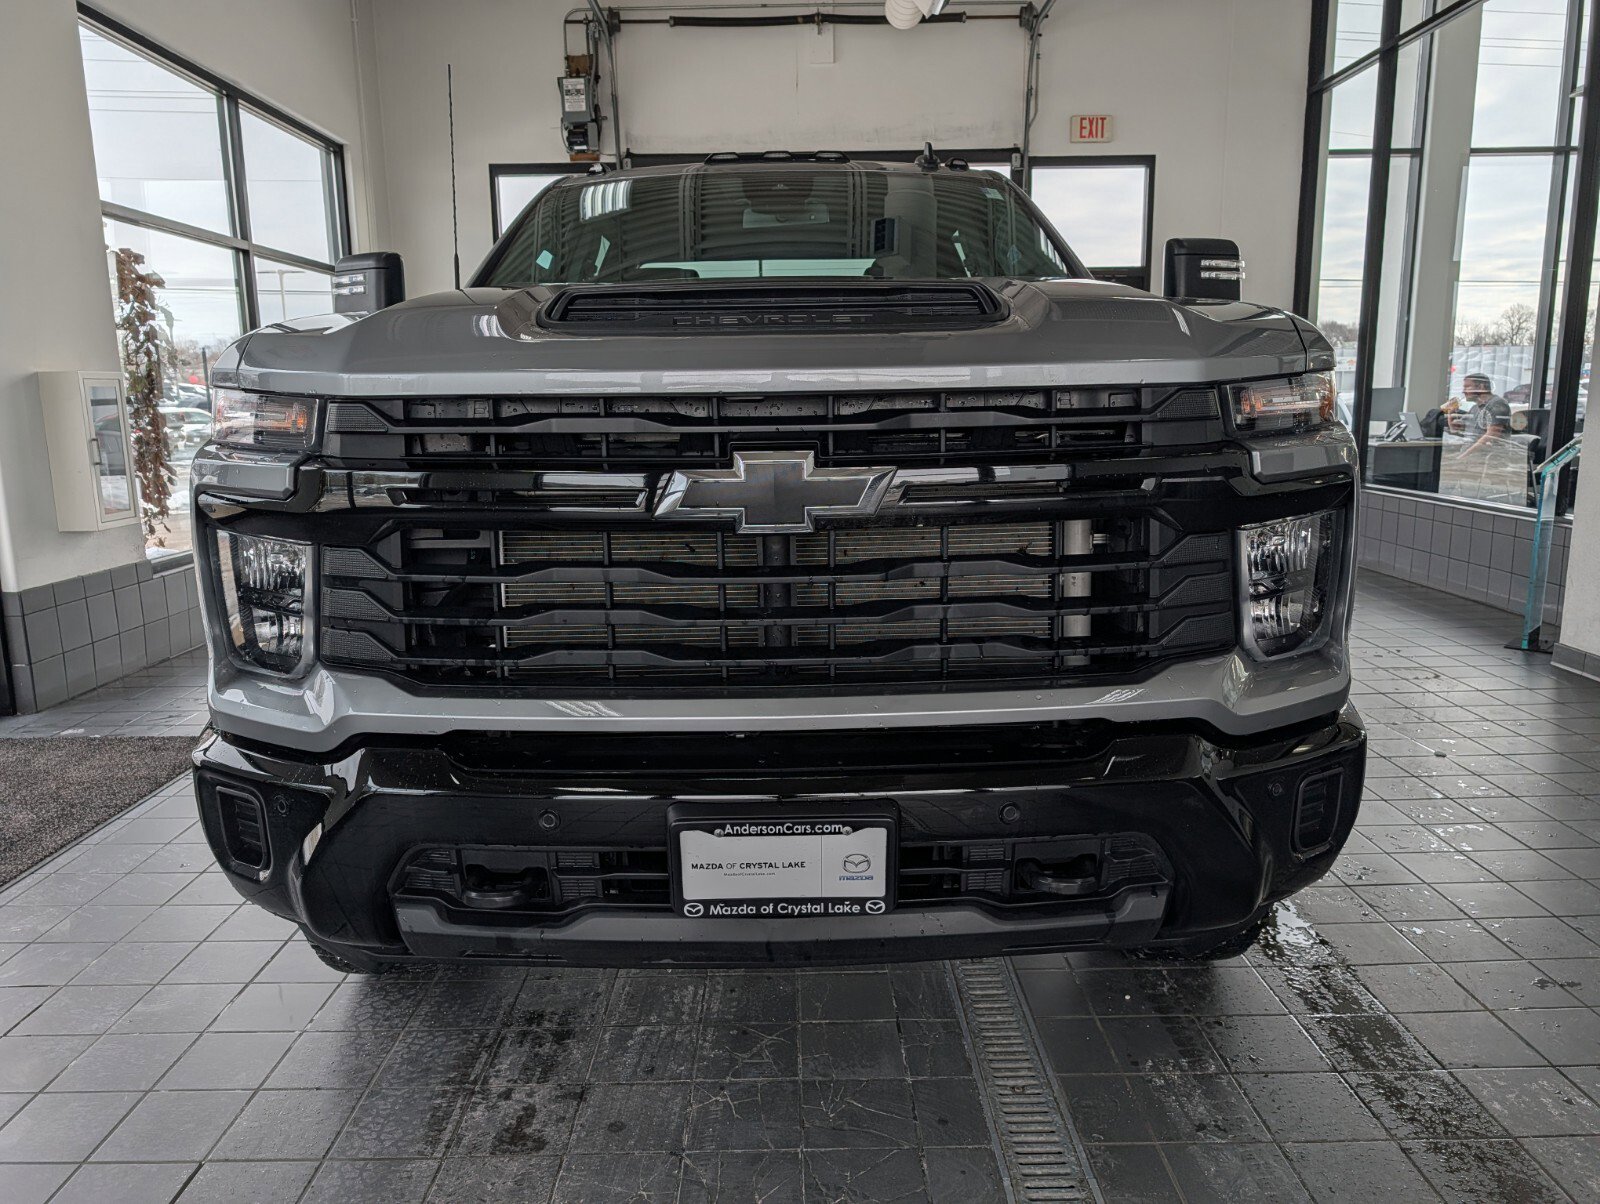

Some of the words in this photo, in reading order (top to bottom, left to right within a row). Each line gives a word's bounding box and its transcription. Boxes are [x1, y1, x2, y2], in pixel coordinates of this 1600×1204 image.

[1079, 116, 1107, 139] EXIT
[672, 313, 874, 326] CHEVROLET
[724, 822, 843, 835] AndersonCars.com
[691, 862, 724, 870] MAZDA
[725, 862, 738, 870] OF
[739, 861, 780, 869] CRYSTAL
[781, 861, 806, 869] LAKE
[709, 903, 757, 915] Mazda
[760, 902, 774, 914] of
[777, 902, 825, 916] Crystal
[828, 902, 861, 913] Lake
